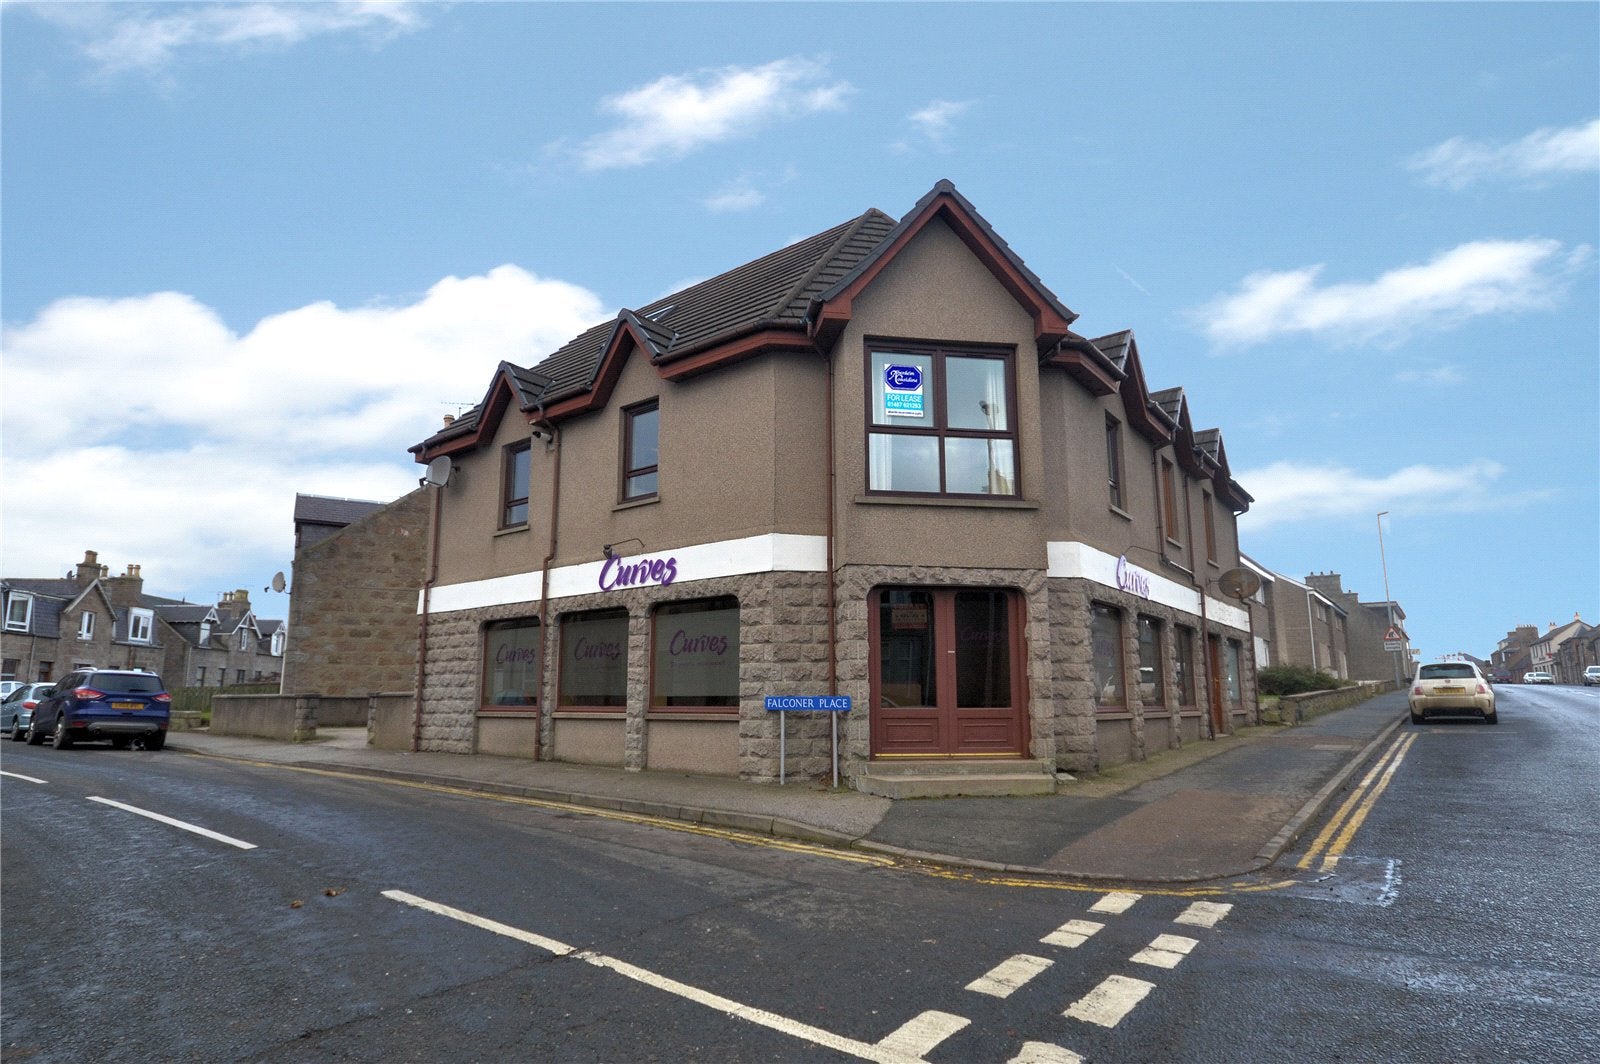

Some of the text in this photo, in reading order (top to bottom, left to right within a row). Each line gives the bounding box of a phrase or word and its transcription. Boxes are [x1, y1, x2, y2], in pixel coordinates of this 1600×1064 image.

[599, 554, 677, 592] Curves
[1116, 554, 1149, 599] Curves
[496, 643, 535, 664] Curves
[574, 637, 622, 660] Curves
[670, 629, 728, 656] Curves
[767, 698, 848, 708] FALCONER PLACE
